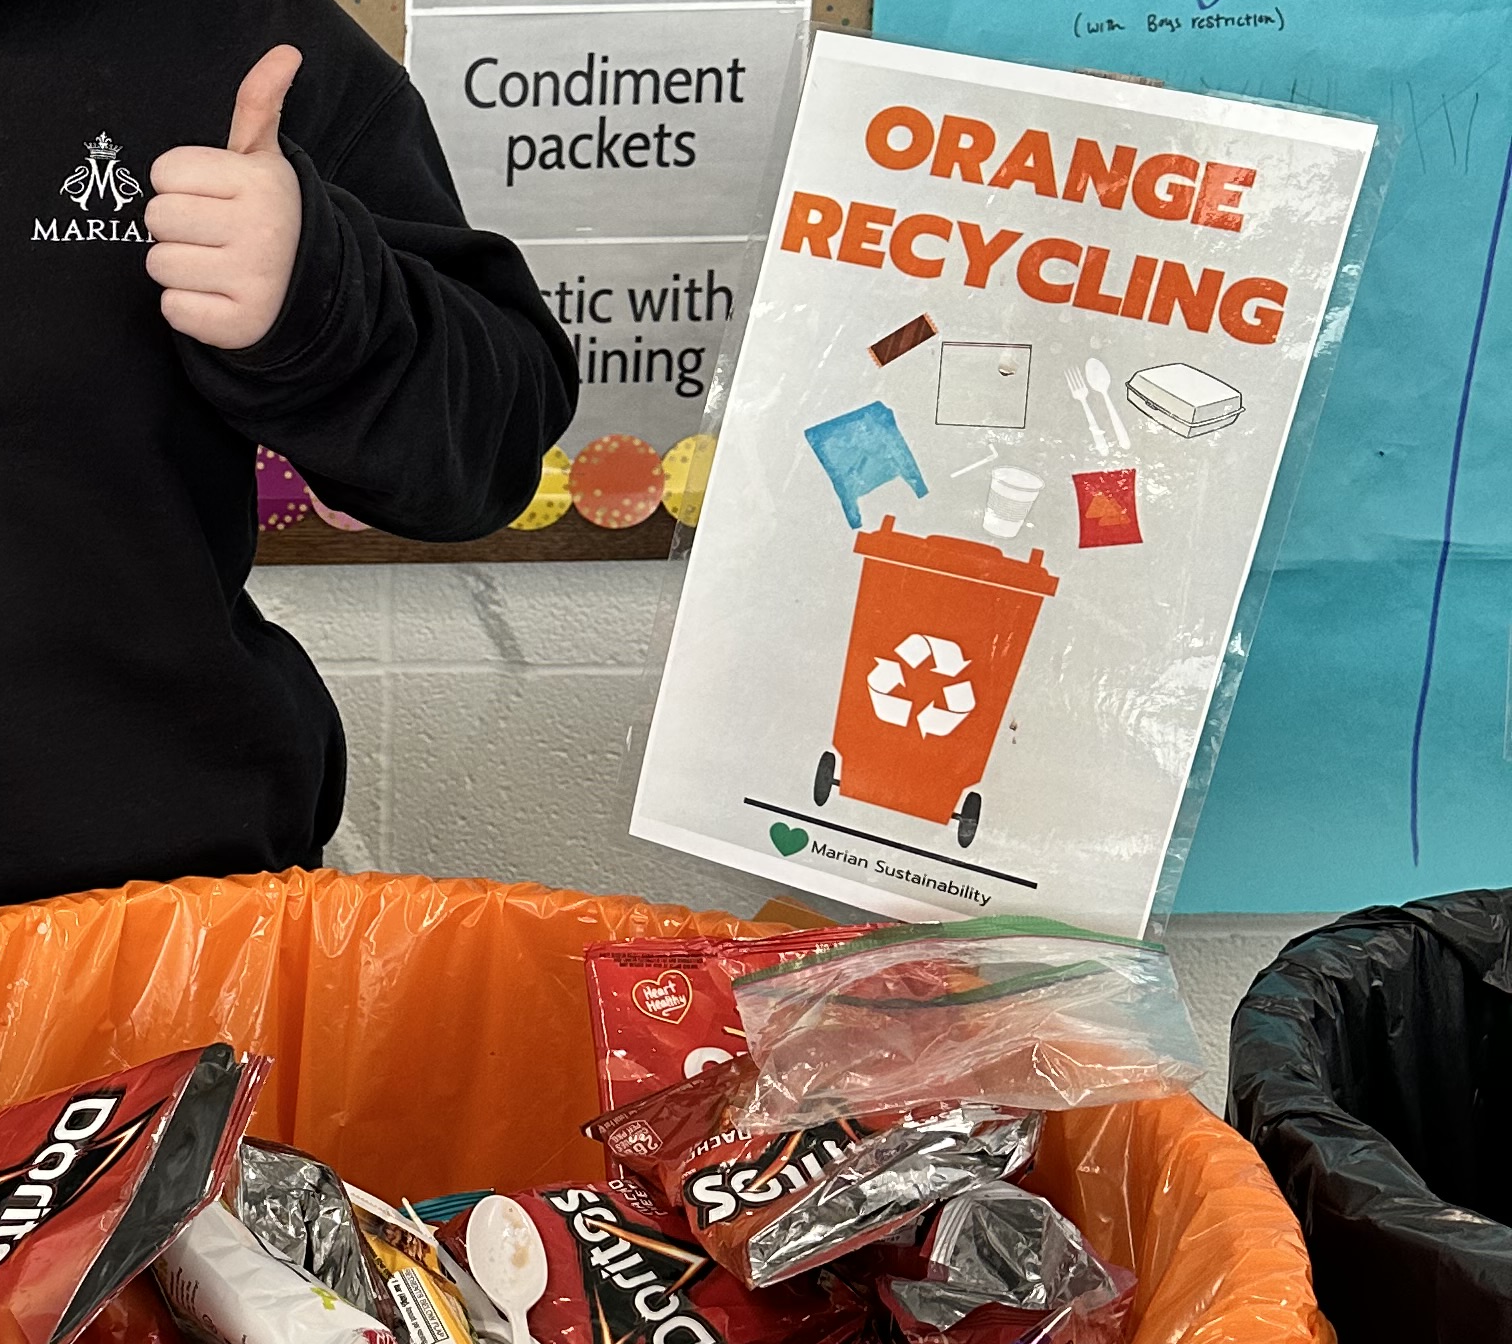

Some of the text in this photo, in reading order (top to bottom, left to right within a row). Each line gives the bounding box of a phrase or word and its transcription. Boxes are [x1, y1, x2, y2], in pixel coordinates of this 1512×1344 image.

[1147, 13, 1183, 34] Boys
[1191, 6, 1285, 31] restriction)
[464, 52, 746, 109] Condiment
[505, 115, 698, 187] packets
[865, 105, 1256, 233] ORANGE
[628, 269, 735, 322] with
[779, 190, 1290, 345] RECYCLING
[811, 840, 992, 906] Marian Sustainability
[643, 980, 677, 999] Heart
[645, 994, 687, 1016] Healthy
